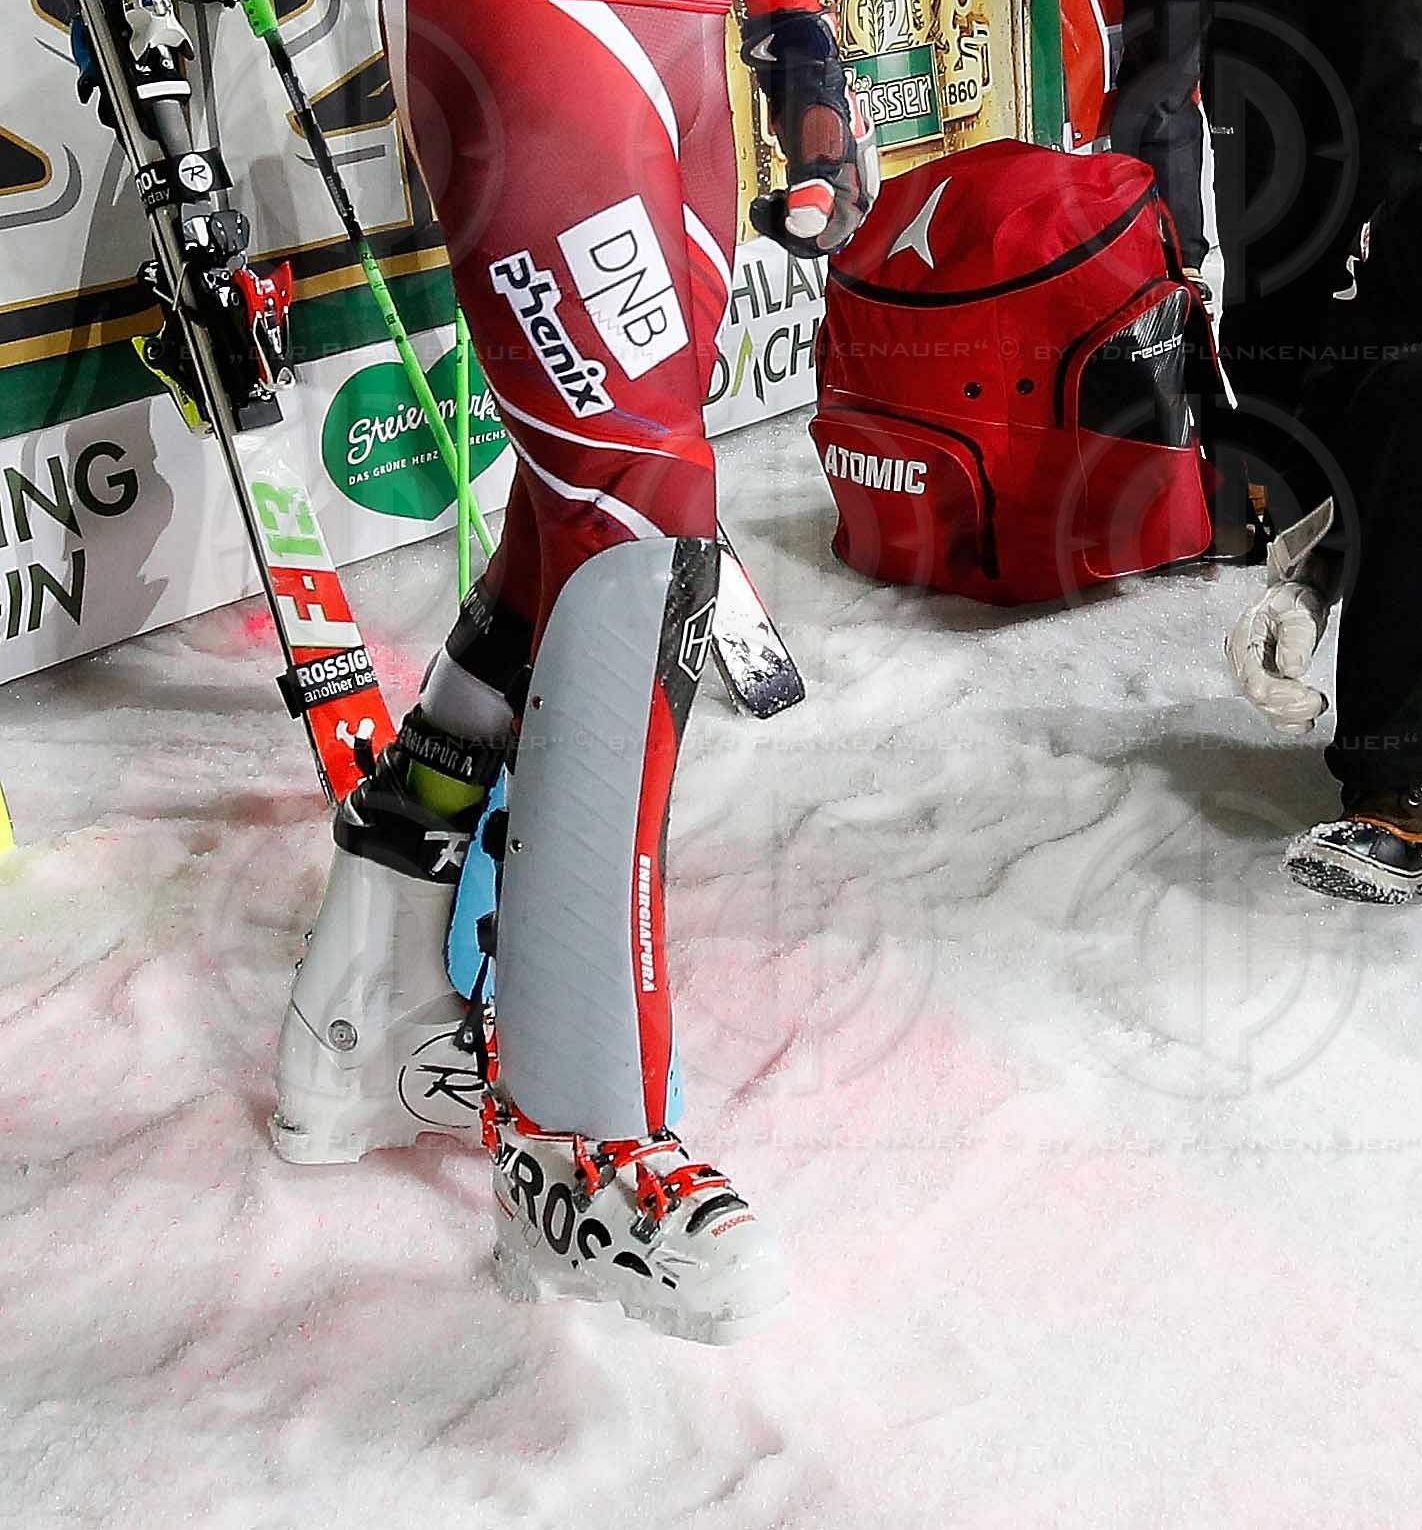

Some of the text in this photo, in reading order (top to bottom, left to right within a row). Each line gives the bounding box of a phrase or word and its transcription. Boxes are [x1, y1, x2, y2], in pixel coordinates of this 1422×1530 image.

[943, 79, 978, 106] 1860
[590, 229, 668, 350] DNB
[348, 472, 370, 486] DAS
[373, 459, 407, 478] GRÜNE
[412, 450, 439, 465] HERZ
[824, 444, 929, 496] ATOMIC
[304, 676, 353, 704] another
